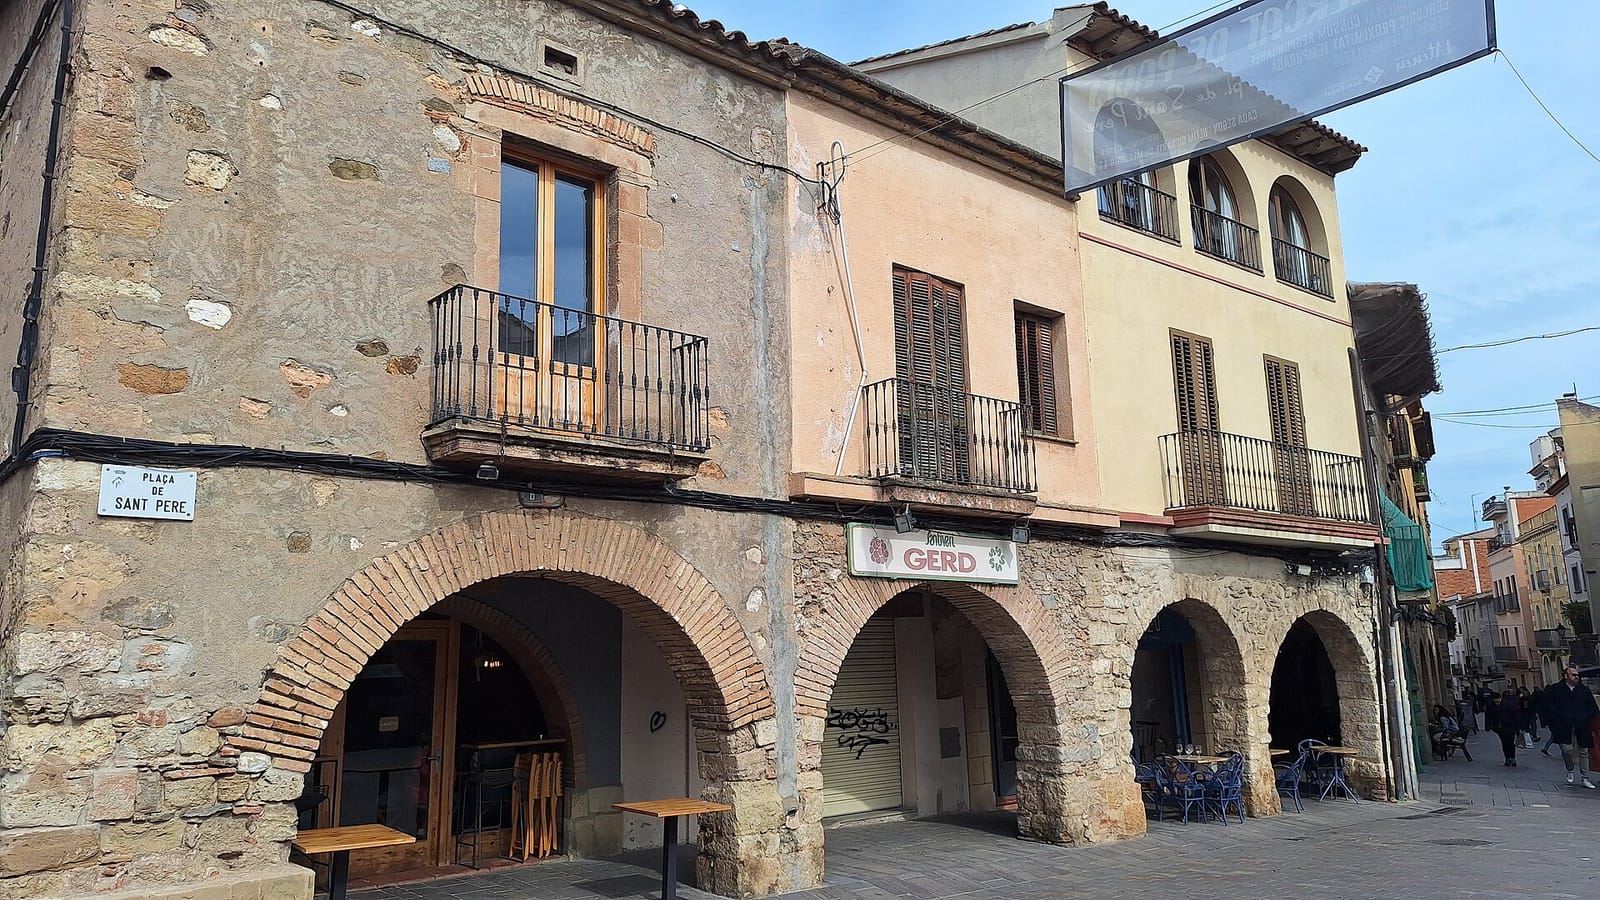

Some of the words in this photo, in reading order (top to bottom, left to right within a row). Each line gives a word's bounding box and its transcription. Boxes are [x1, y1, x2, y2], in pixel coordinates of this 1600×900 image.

[142, 472, 175, 485] PLAÇA
[151, 486, 164, 496] DE
[115, 496, 149, 511] SANT
[155, 499, 187, 514] PERE
[903, 547, 977, 573] GERD
